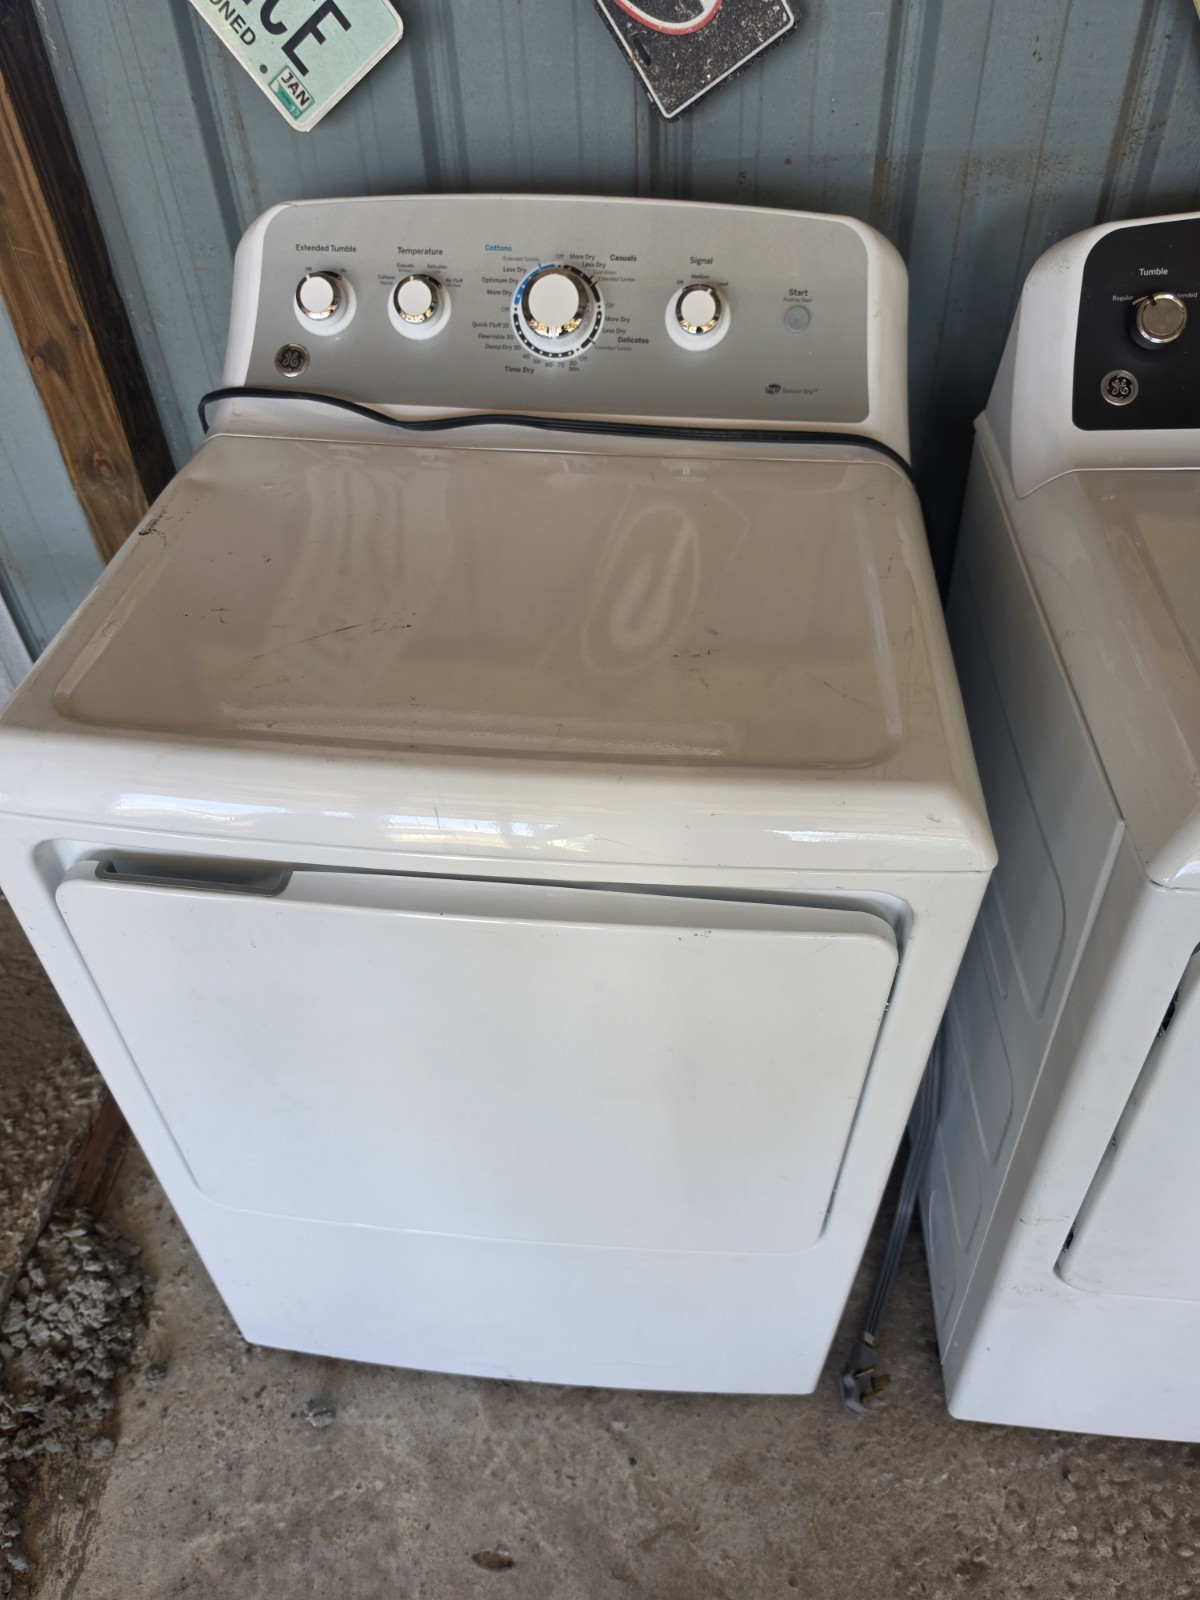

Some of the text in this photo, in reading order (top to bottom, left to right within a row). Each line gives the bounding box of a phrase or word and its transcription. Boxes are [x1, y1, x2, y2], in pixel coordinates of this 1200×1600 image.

[281, 72, 310, 106] JAN
[296, 244, 357, 253] Extended Tumble
[398, 247, 443, 256] Temperature
[485, 244, 512, 252] Cottons
[610, 254, 637, 262] Casuals
[690, 257, 713, 265] Signal
[1139, 268, 1168, 276] Tumble
[482, 277, 506, 285] Optimum
[788, 289, 808, 297] Start
[472, 321, 488, 329] Quick
[618, 336, 649, 344] Delicates
[523, 367, 535, 375] Dry
